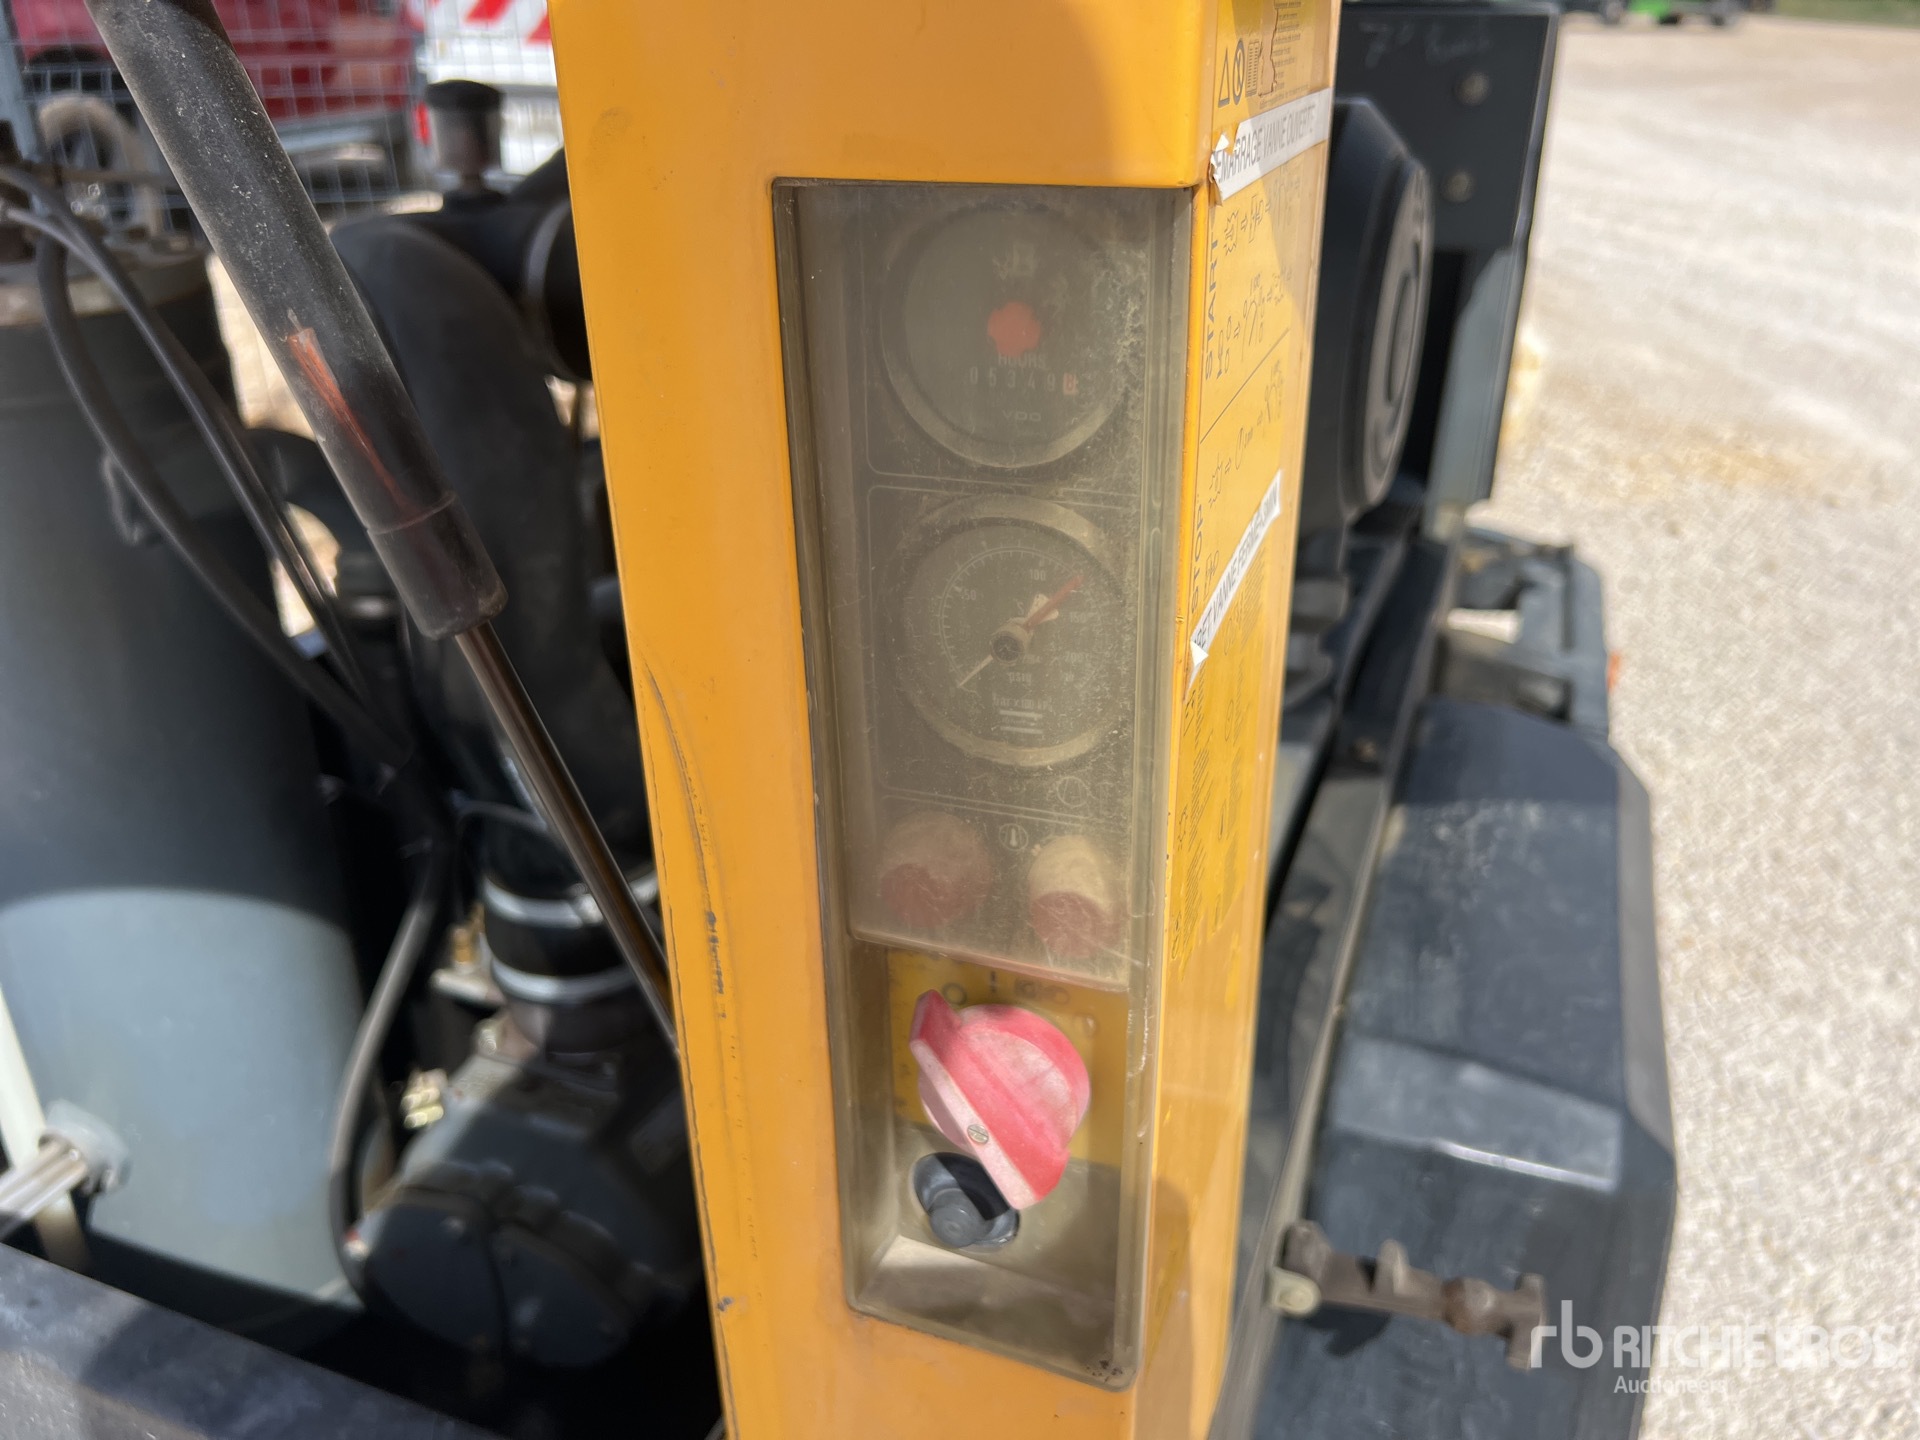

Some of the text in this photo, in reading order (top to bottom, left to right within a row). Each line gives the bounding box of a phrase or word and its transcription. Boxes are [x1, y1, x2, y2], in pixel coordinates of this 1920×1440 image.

[1205, 231, 1219, 380] START
[998, 352, 1048, 369] HOURS
[1002, 410, 1042, 423] VDO
[1191, 503, 1204, 614] STOP
[1030, 569, 1046, 582] 100
